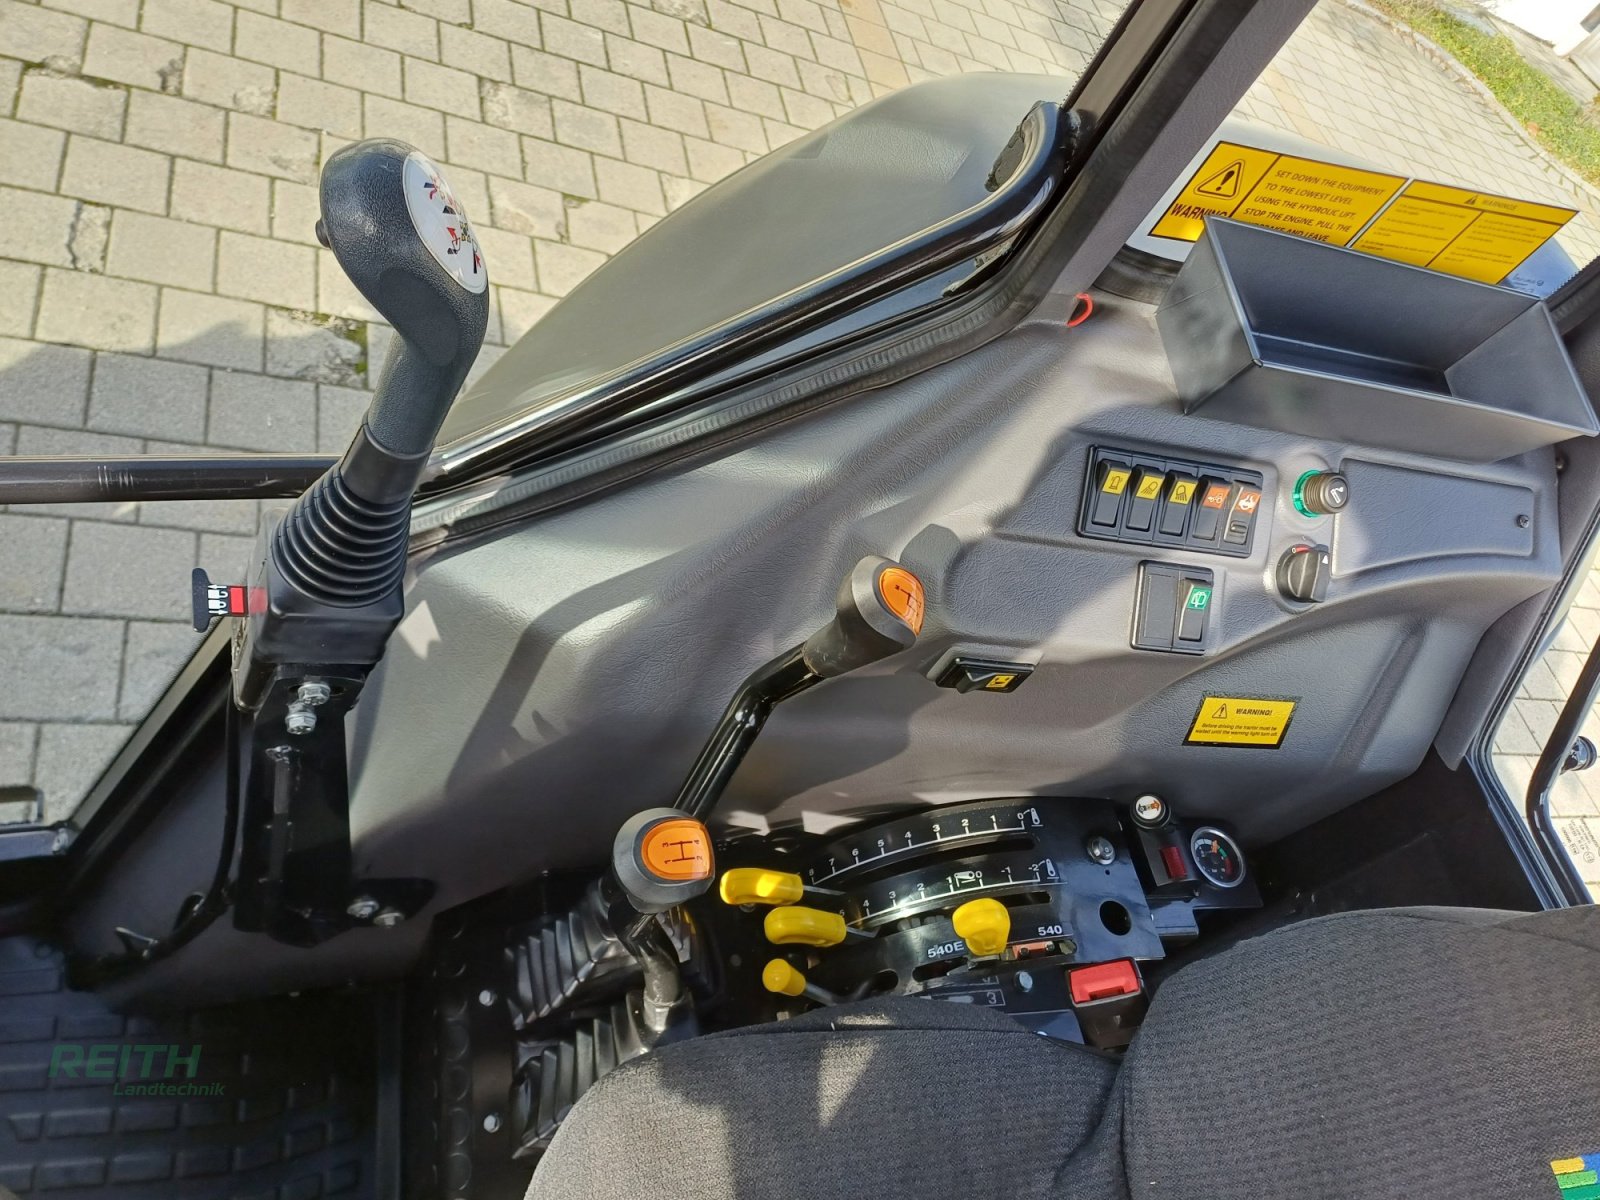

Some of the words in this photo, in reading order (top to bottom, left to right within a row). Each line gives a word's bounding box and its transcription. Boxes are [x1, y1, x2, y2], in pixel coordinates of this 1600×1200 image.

[1265, 182, 1278, 191] TO
[1279, 185, 1295, 194] THE
[1295, 189, 1329, 200] LOWEST
[1275, 170, 1291, 178] SET
[1292, 173, 1321, 184] DOWN
[1321, 178, 1337, 187] THE
[1337, 182, 1385, 195] EQUIPMENT
[1254, 195, 1281, 206] USING
[1281, 200, 1298, 209] THE
[1243, 207, 1267, 217] STOP
[1266, 211, 1284, 221] THE
[1315, 220, 1335, 230] PULL
[1336, 224, 1352, 233] THE
[1236, 708, 1272, 716] WARNING!
[828, 857, 835, 866] 7
[852, 848, 859, 856] 6
[877, 839, 885, 848] 5
[904, 831, 912, 839] 4
[932, 824, 941, 832] 3
[961, 818, 970, 827] 2
[989, 814, 996, 822] 1
[1016, 812, 1024, 820] 0
[889, 891, 896, 899] 3
[917, 883, 925, 891] 2
[945, 876, 952, 884] 1
[975, 870, 983, 878] 0
[1028, 863, 1040, 871] -2
[1037, 924, 1063, 937] 540
[927, 940, 965, 958] 540E
[986, 991, 997, 1005] 3
